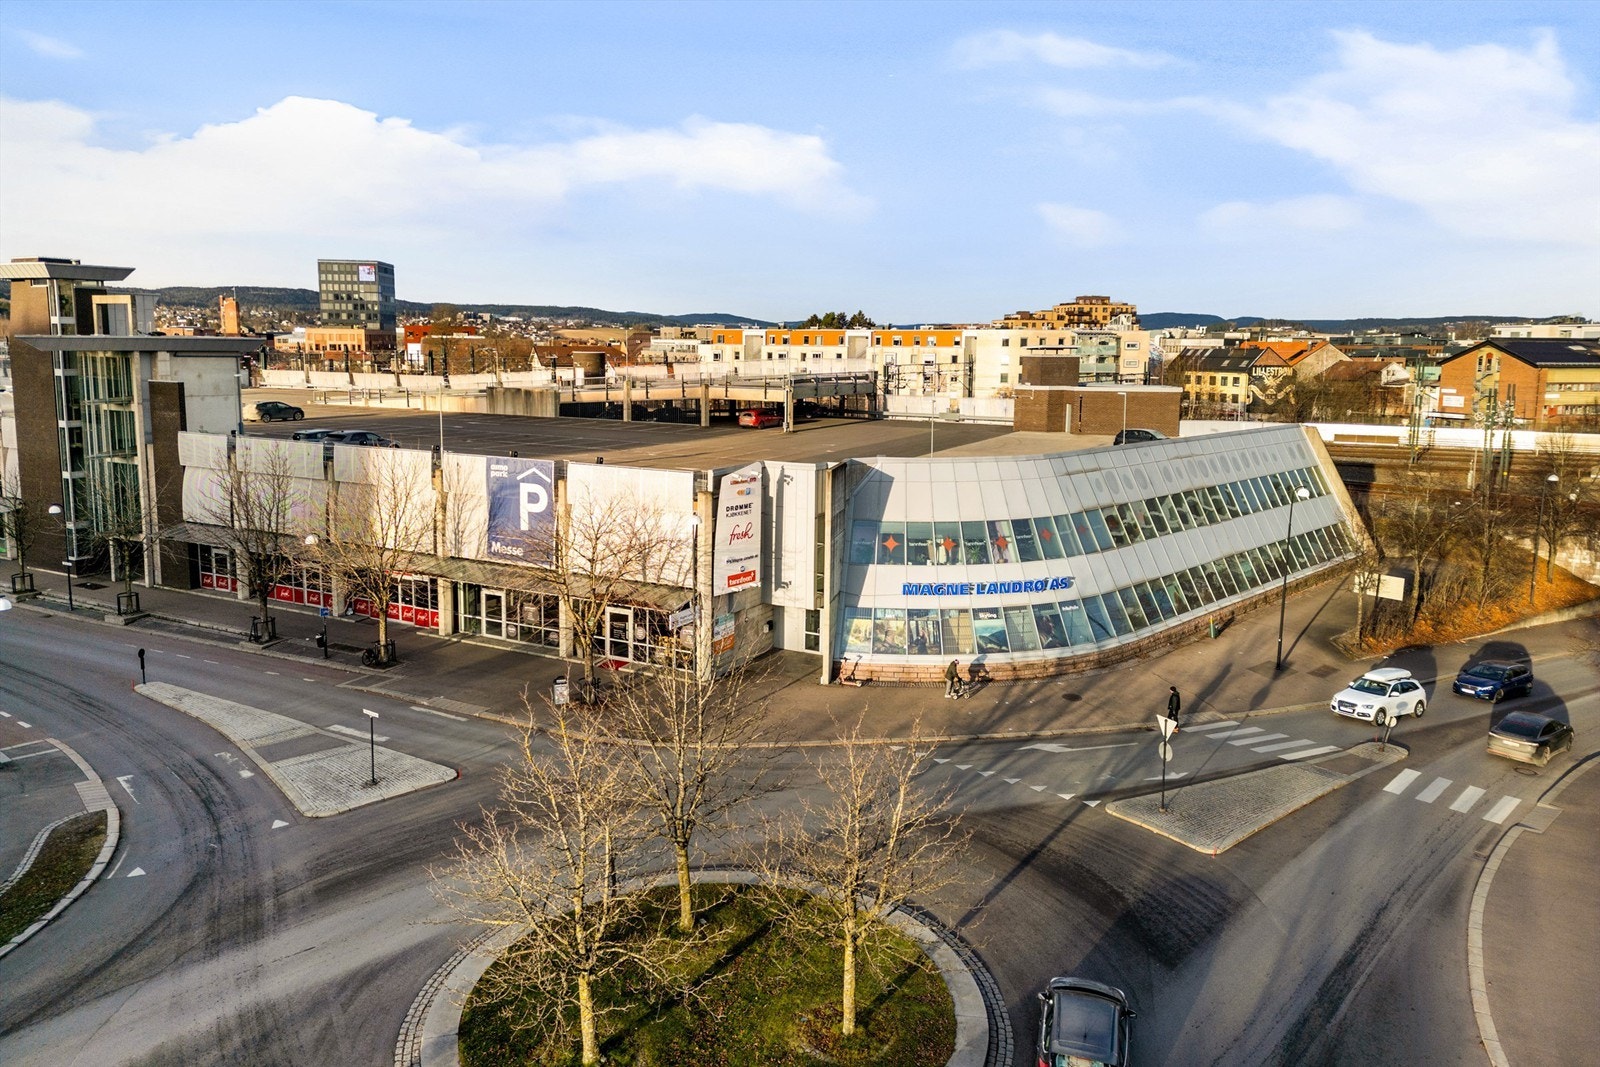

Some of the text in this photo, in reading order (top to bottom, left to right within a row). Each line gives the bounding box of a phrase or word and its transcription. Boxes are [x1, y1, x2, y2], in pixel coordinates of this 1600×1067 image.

[490, 470, 508, 478] park
[519, 482, 549, 531] P
[725, 502, 753, 513] DRØMME
[728, 521, 754, 546] fresh
[491, 541, 524, 556] Messe
[902, 577, 1070, 596] MAGNE LANDRØ AS
